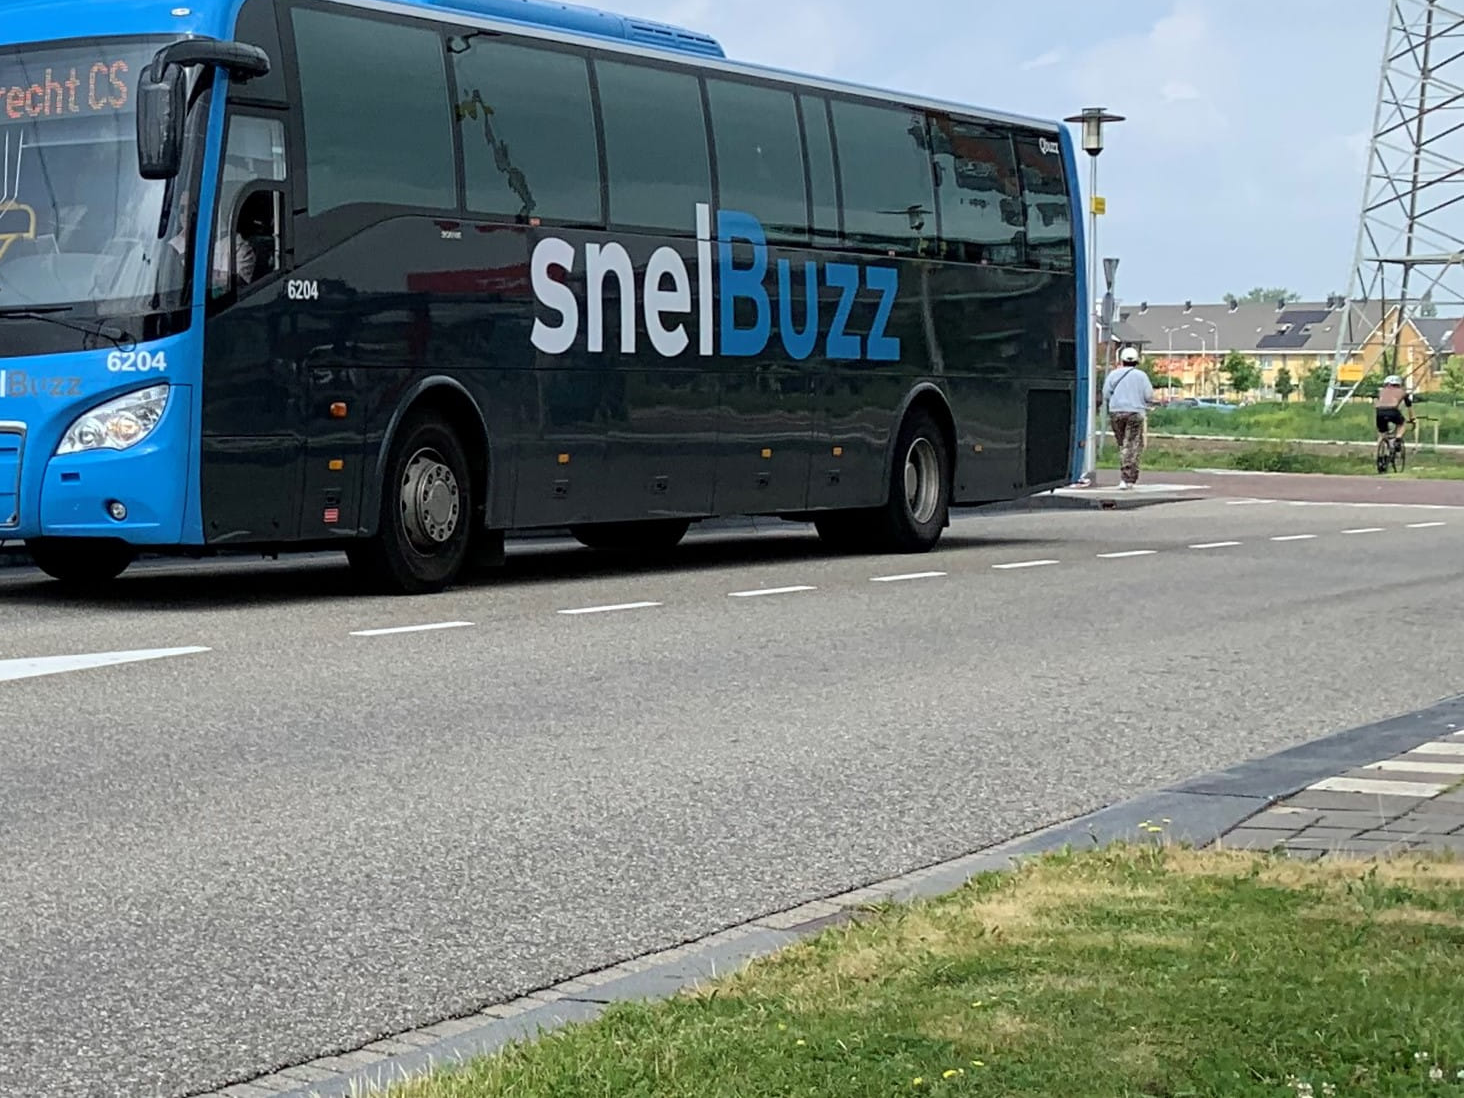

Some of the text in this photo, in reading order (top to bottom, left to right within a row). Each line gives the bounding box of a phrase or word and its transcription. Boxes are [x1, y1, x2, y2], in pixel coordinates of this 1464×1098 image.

[88, 59, 129, 110] CS
[287, 280, 319, 300] 6204
[530, 203, 900, 361] snelBuzz
[107, 351, 167, 372] 6204
